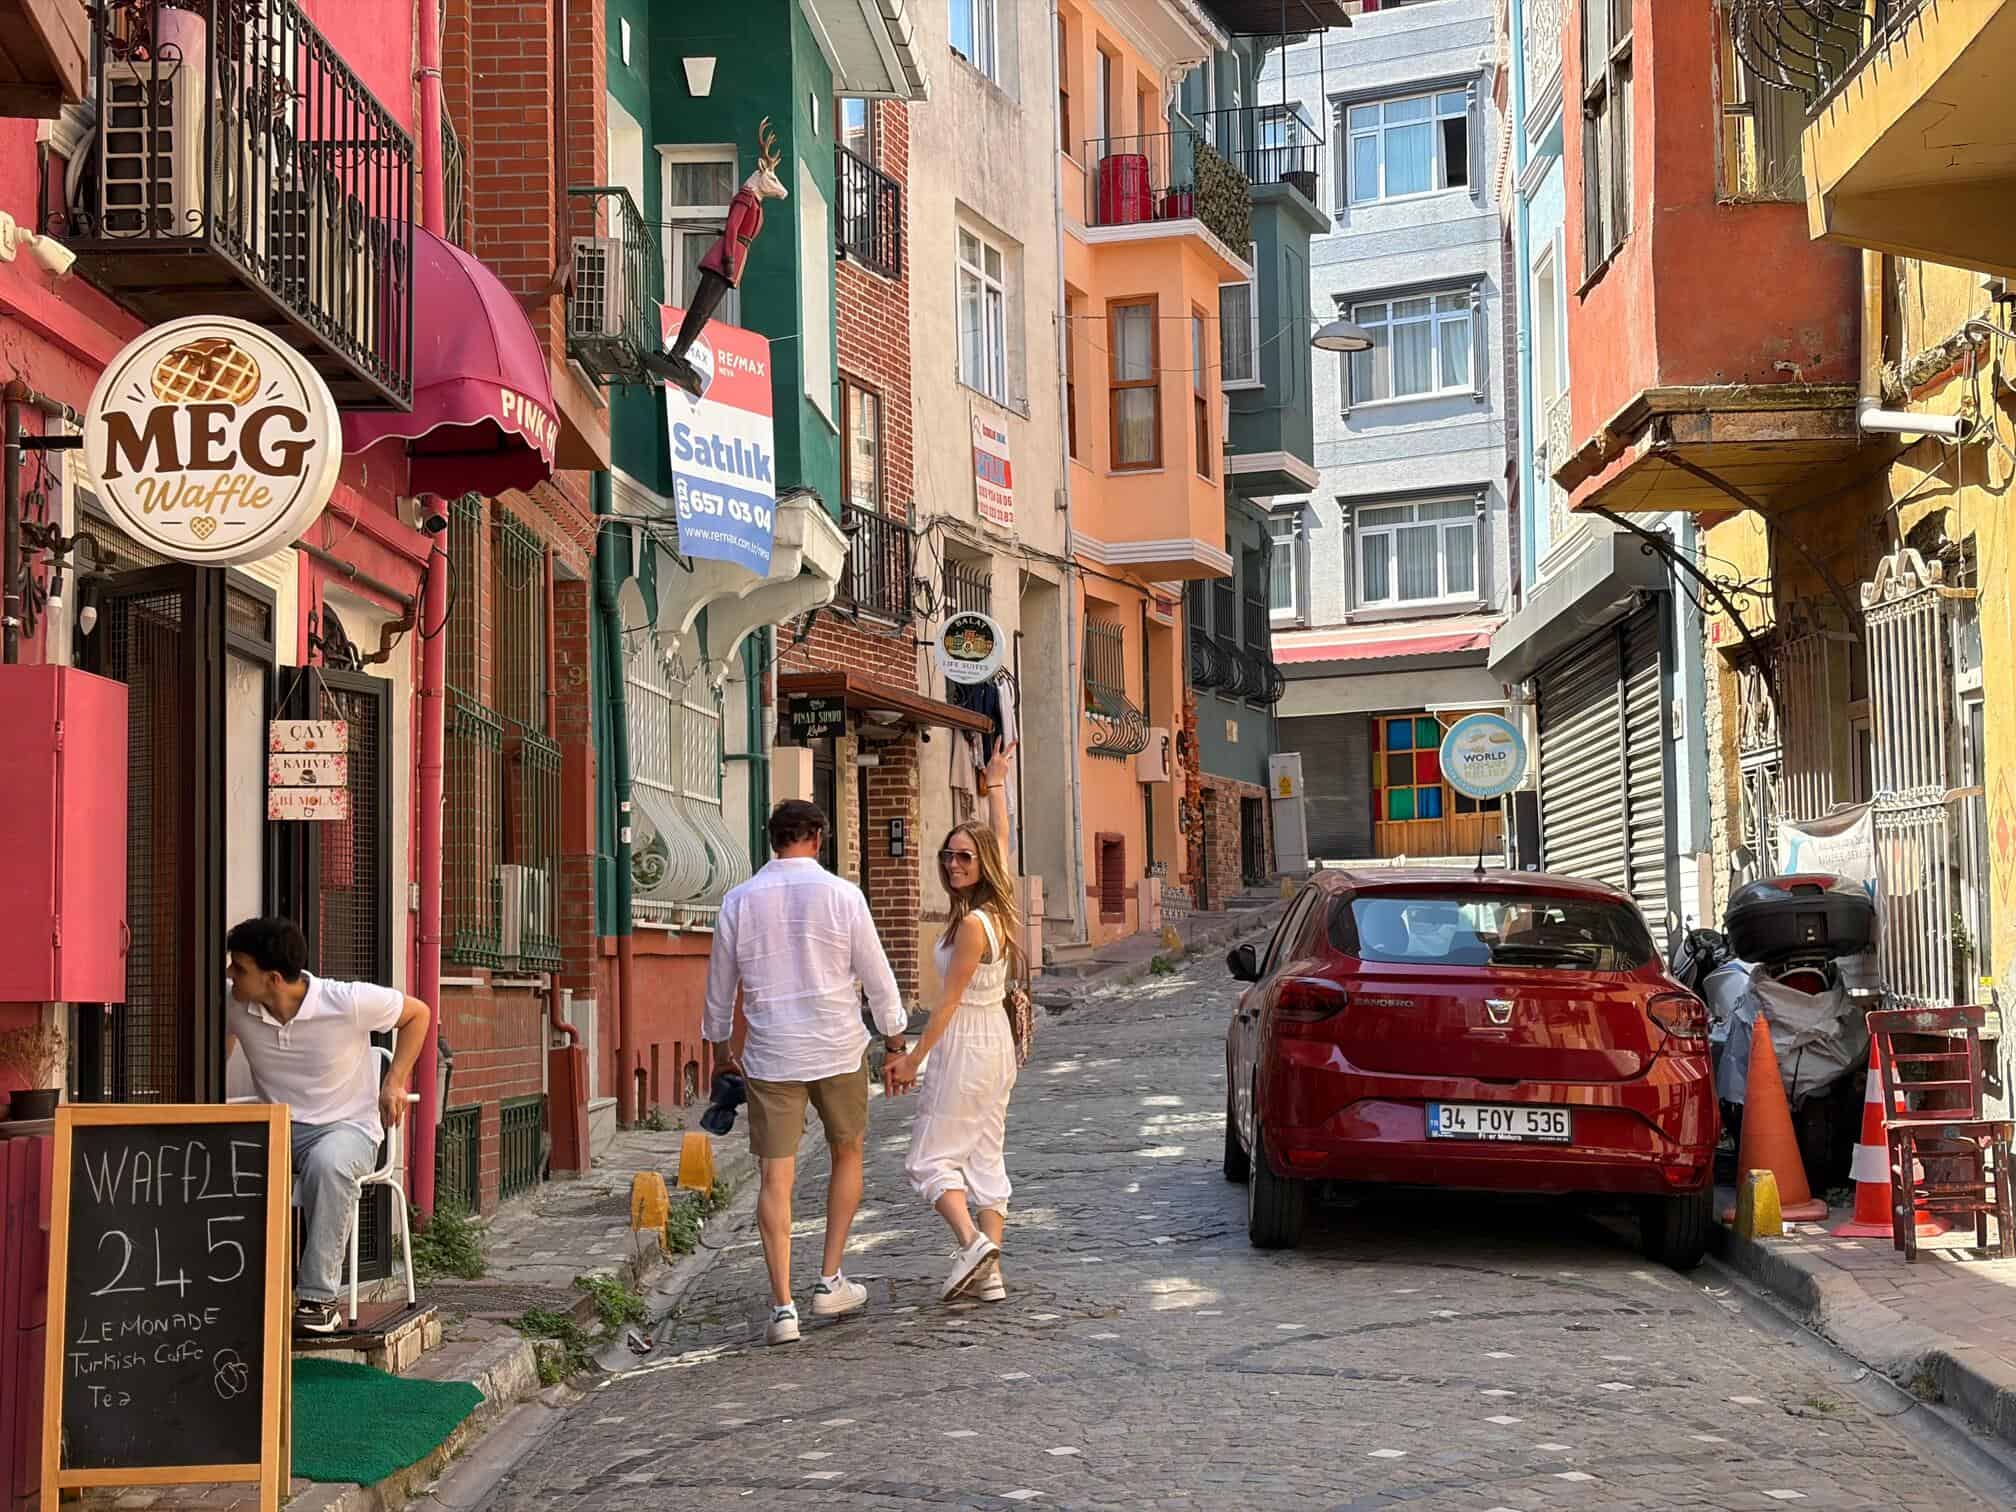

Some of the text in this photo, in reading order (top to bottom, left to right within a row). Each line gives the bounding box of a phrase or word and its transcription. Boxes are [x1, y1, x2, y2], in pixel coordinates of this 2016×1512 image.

[718, 350, 765, 377] RE/MAX
[501, 388, 547, 442] PINK
[101, 403, 316, 480] MEG
[673, 422, 772, 484] Satılık
[135, 474, 273, 514] Waffle
[690, 490, 772, 534] 657 03 04
[955, 617, 987, 629] BALAT
[943, 660, 959, 669] LIFE
[961, 662, 989, 672] SUITES
[290, 725, 327, 742] ÇAY
[283, 759, 330, 770] KAHVE
[1463, 751, 1506, 762] WORLD
[1441, 1107, 1565, 1134] 34 FOY 536
[83, 1140, 263, 1206] WAFFLE
[90, 1216, 246, 1299] 245
[77, 1307, 221, 1345] LEMONADE
[67, 1351, 146, 1378] Turkish
[88, 1385, 132, 1408] Tea
